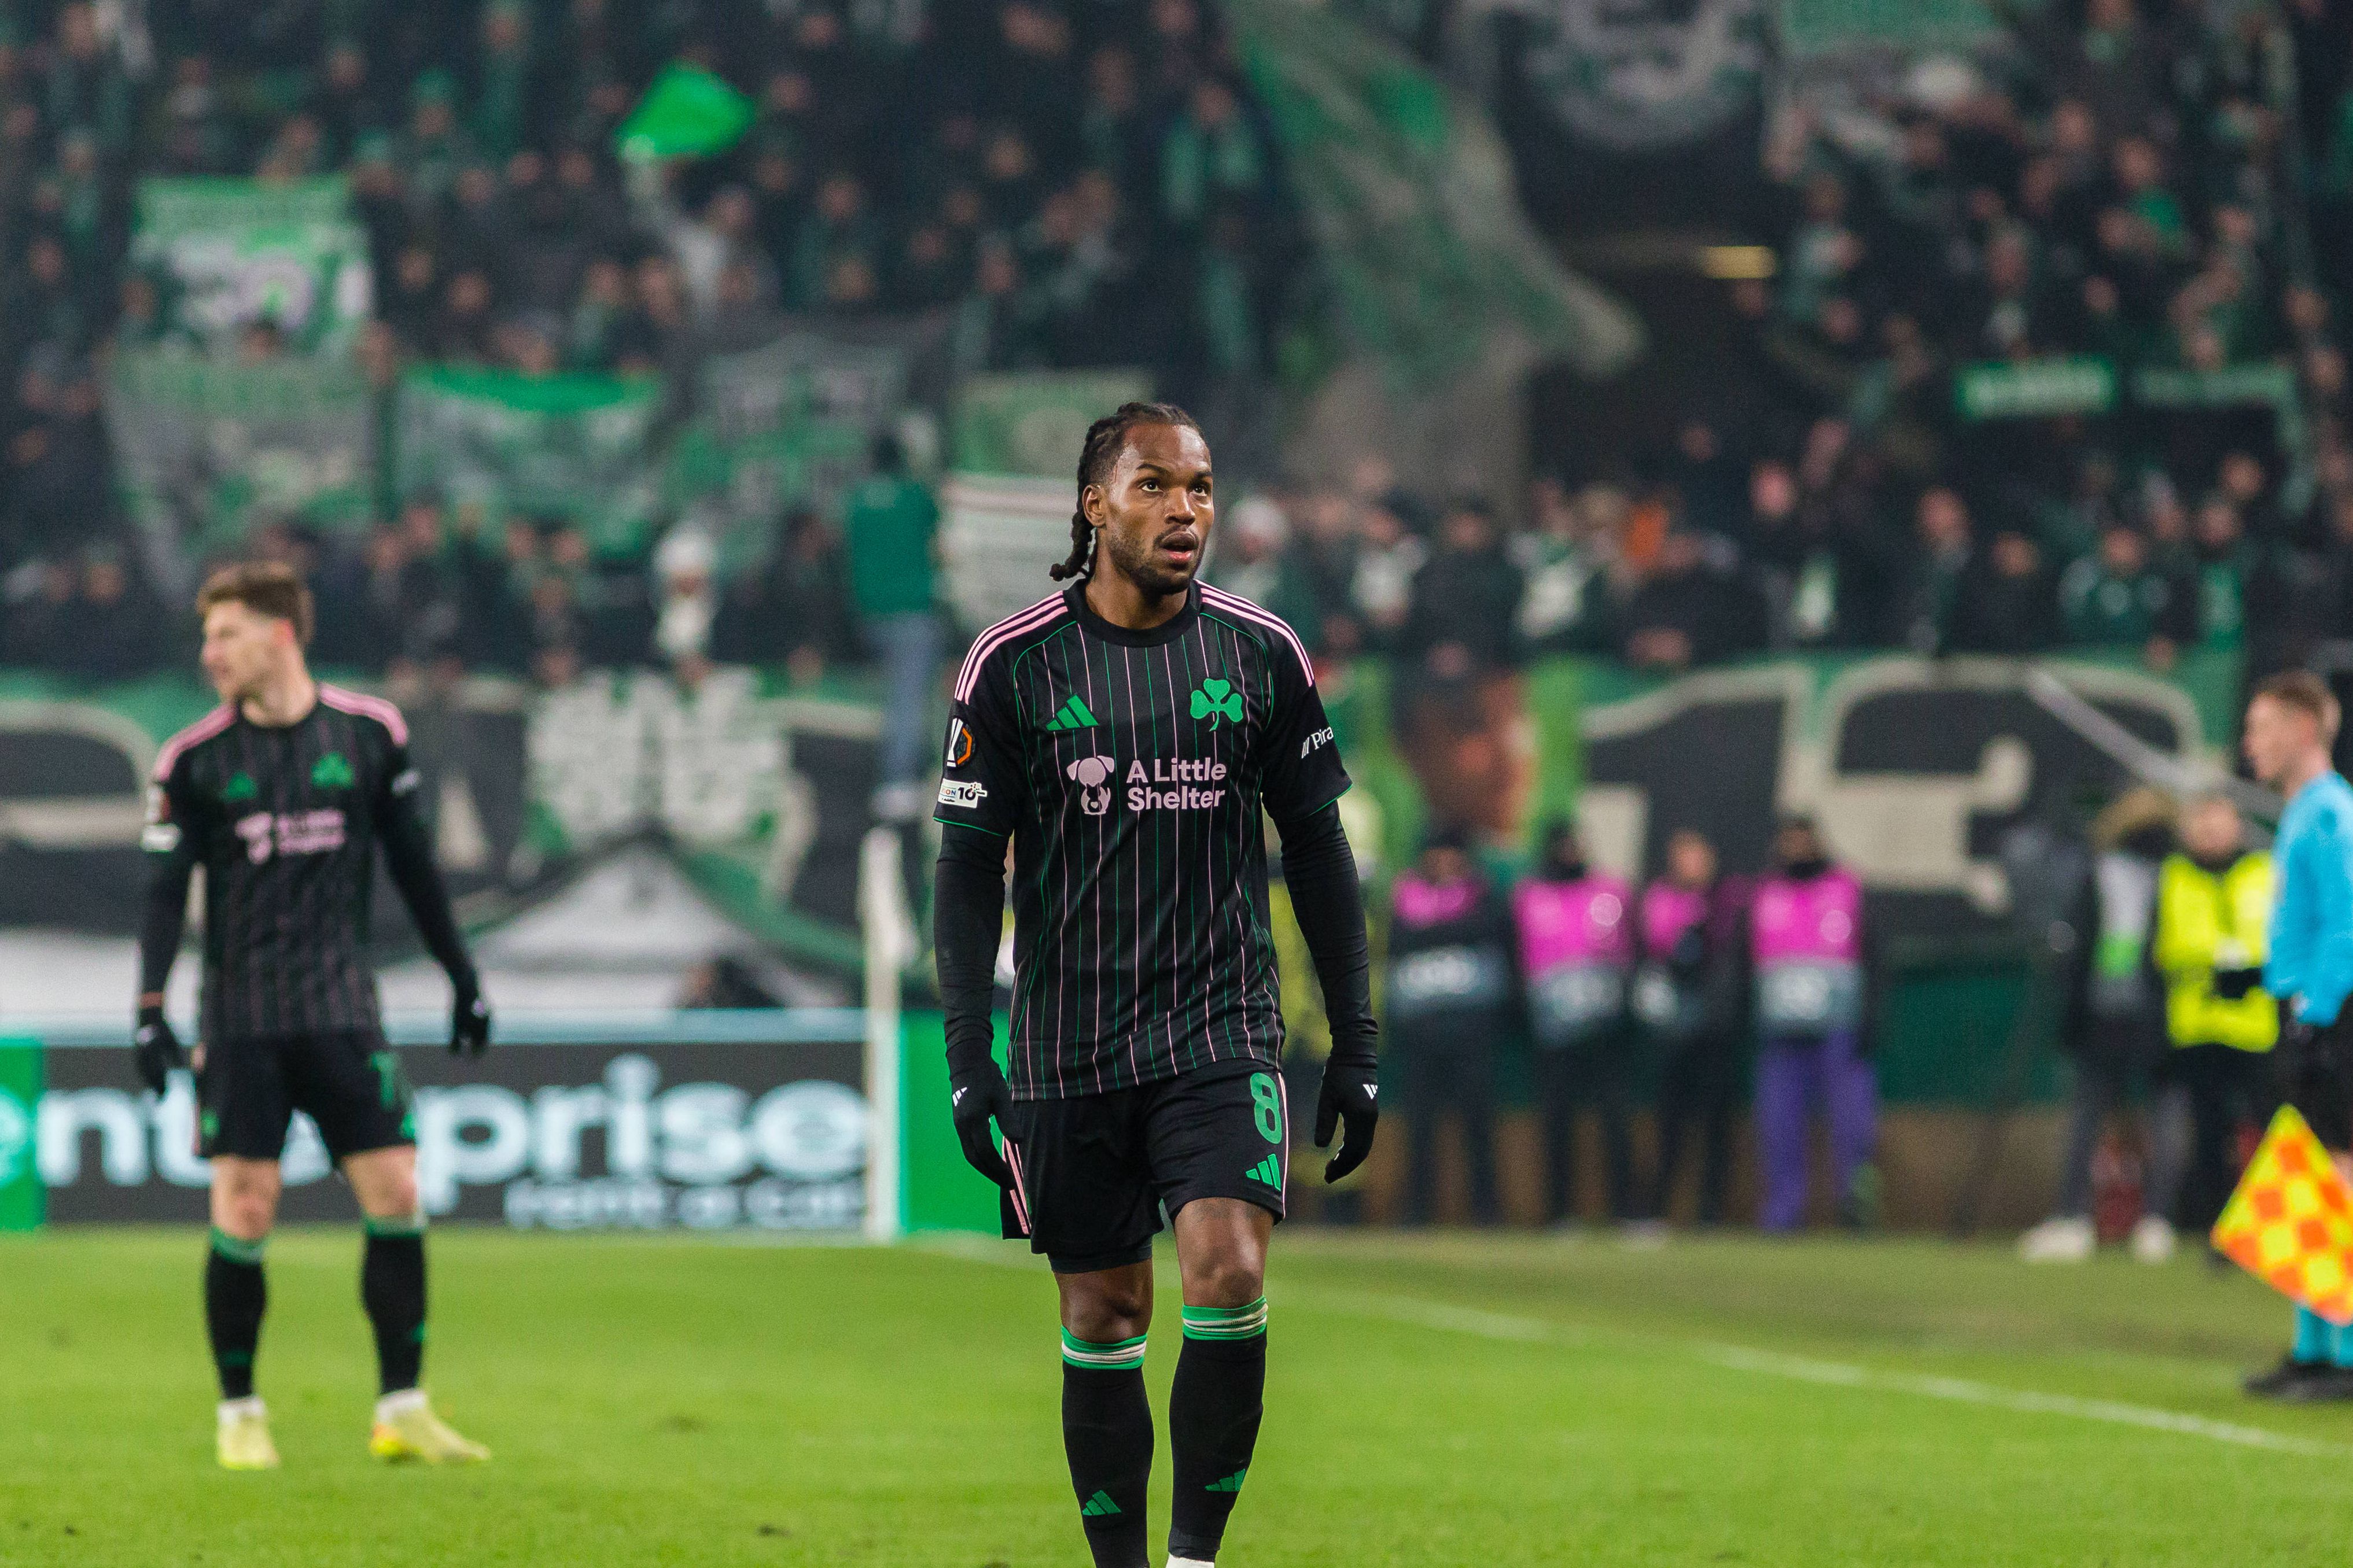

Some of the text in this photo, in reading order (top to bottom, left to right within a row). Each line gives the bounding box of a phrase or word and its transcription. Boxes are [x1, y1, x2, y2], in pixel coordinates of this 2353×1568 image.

[1310, 726, 1334, 750] Pira
[1126, 757, 1227, 783] A Little
[1128, 785, 1225, 811] Shelter
[1250, 1072, 1283, 1145] 8
